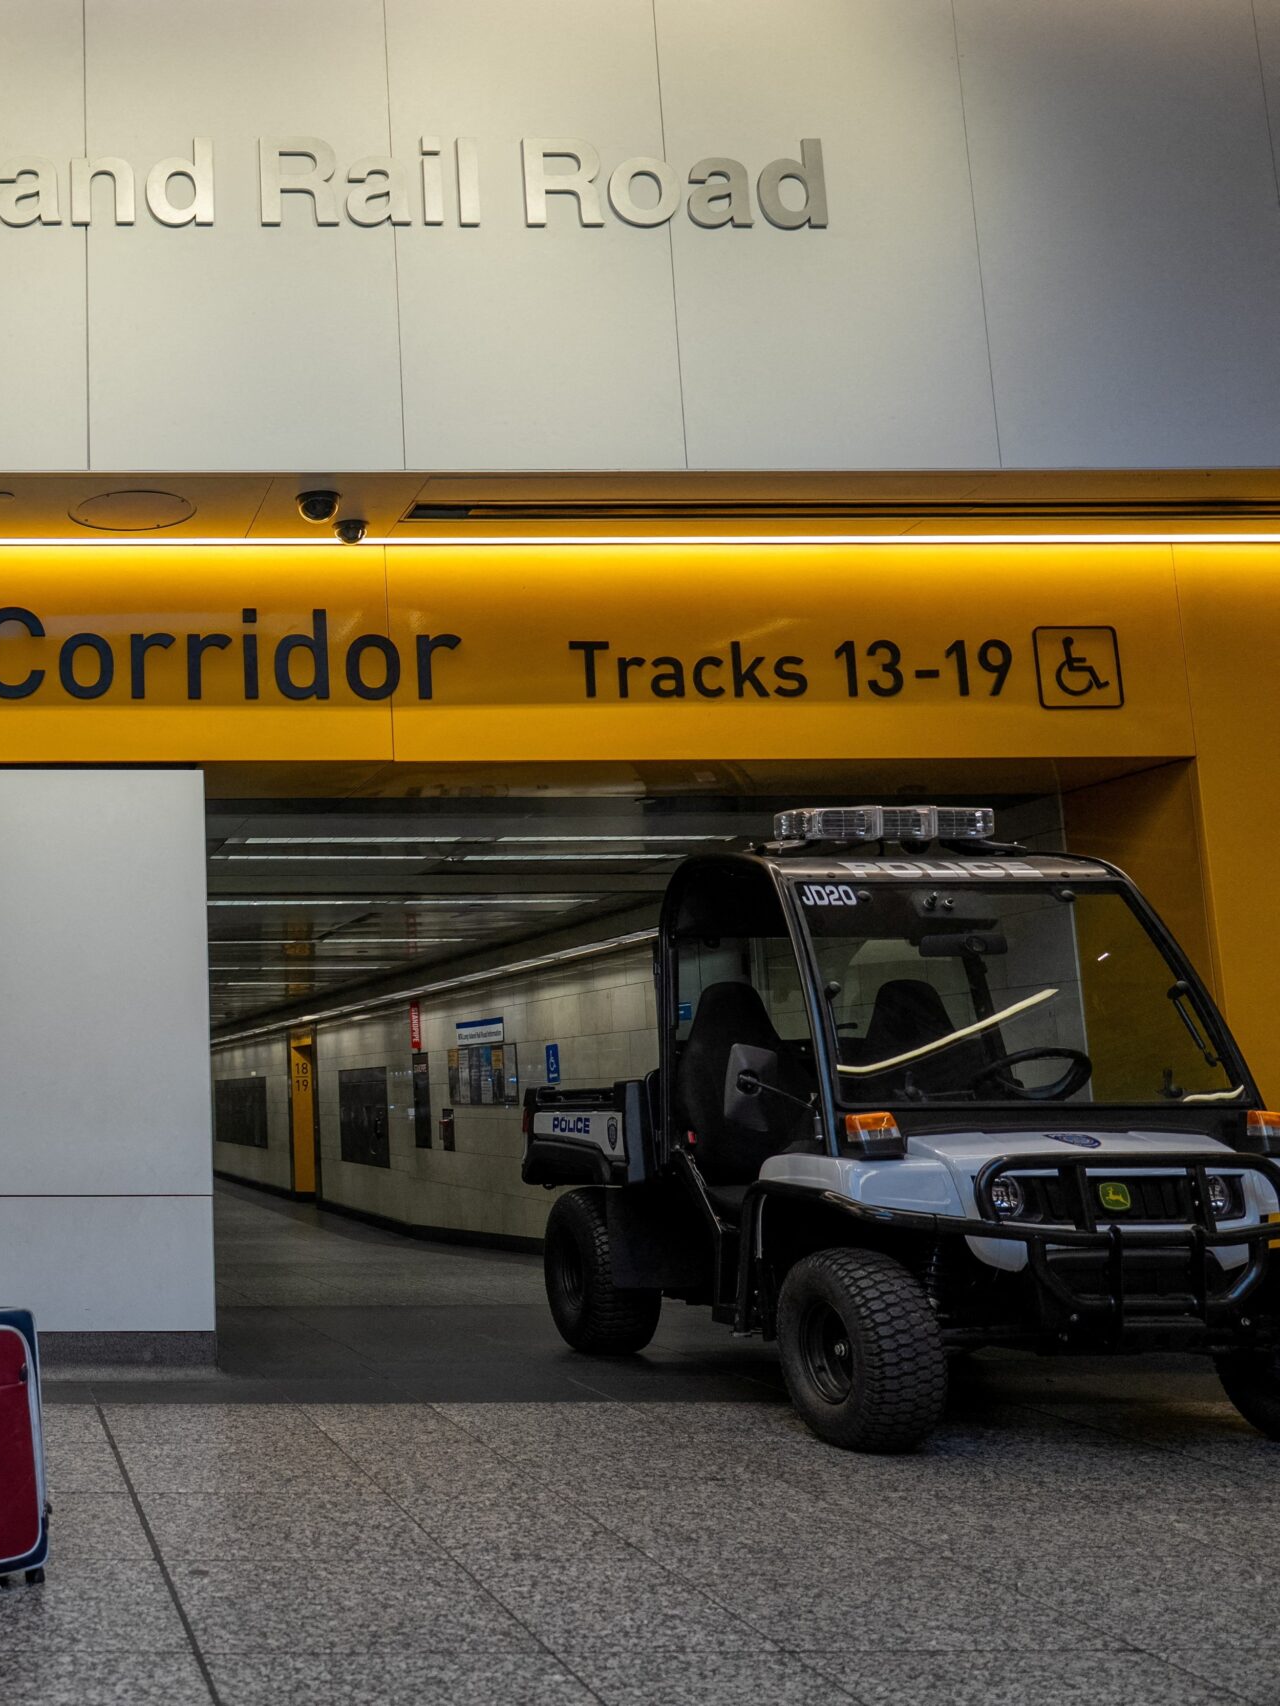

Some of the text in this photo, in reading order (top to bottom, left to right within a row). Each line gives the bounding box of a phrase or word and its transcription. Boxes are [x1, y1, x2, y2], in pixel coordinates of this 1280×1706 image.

[257, 135, 481, 228] Rail
[520, 136, 829, 230] Road
[568, 638, 1014, 699] Tracks 13-19
[836, 861, 1045, 878] POLICE
[801, 884, 858, 906] JD20
[410, 1006, 421, 1043] STANDPIPE
[295, 1062, 309, 1075] 18
[295, 1079, 309, 1092] 19
[552, 1116, 591, 1135] POLICE
